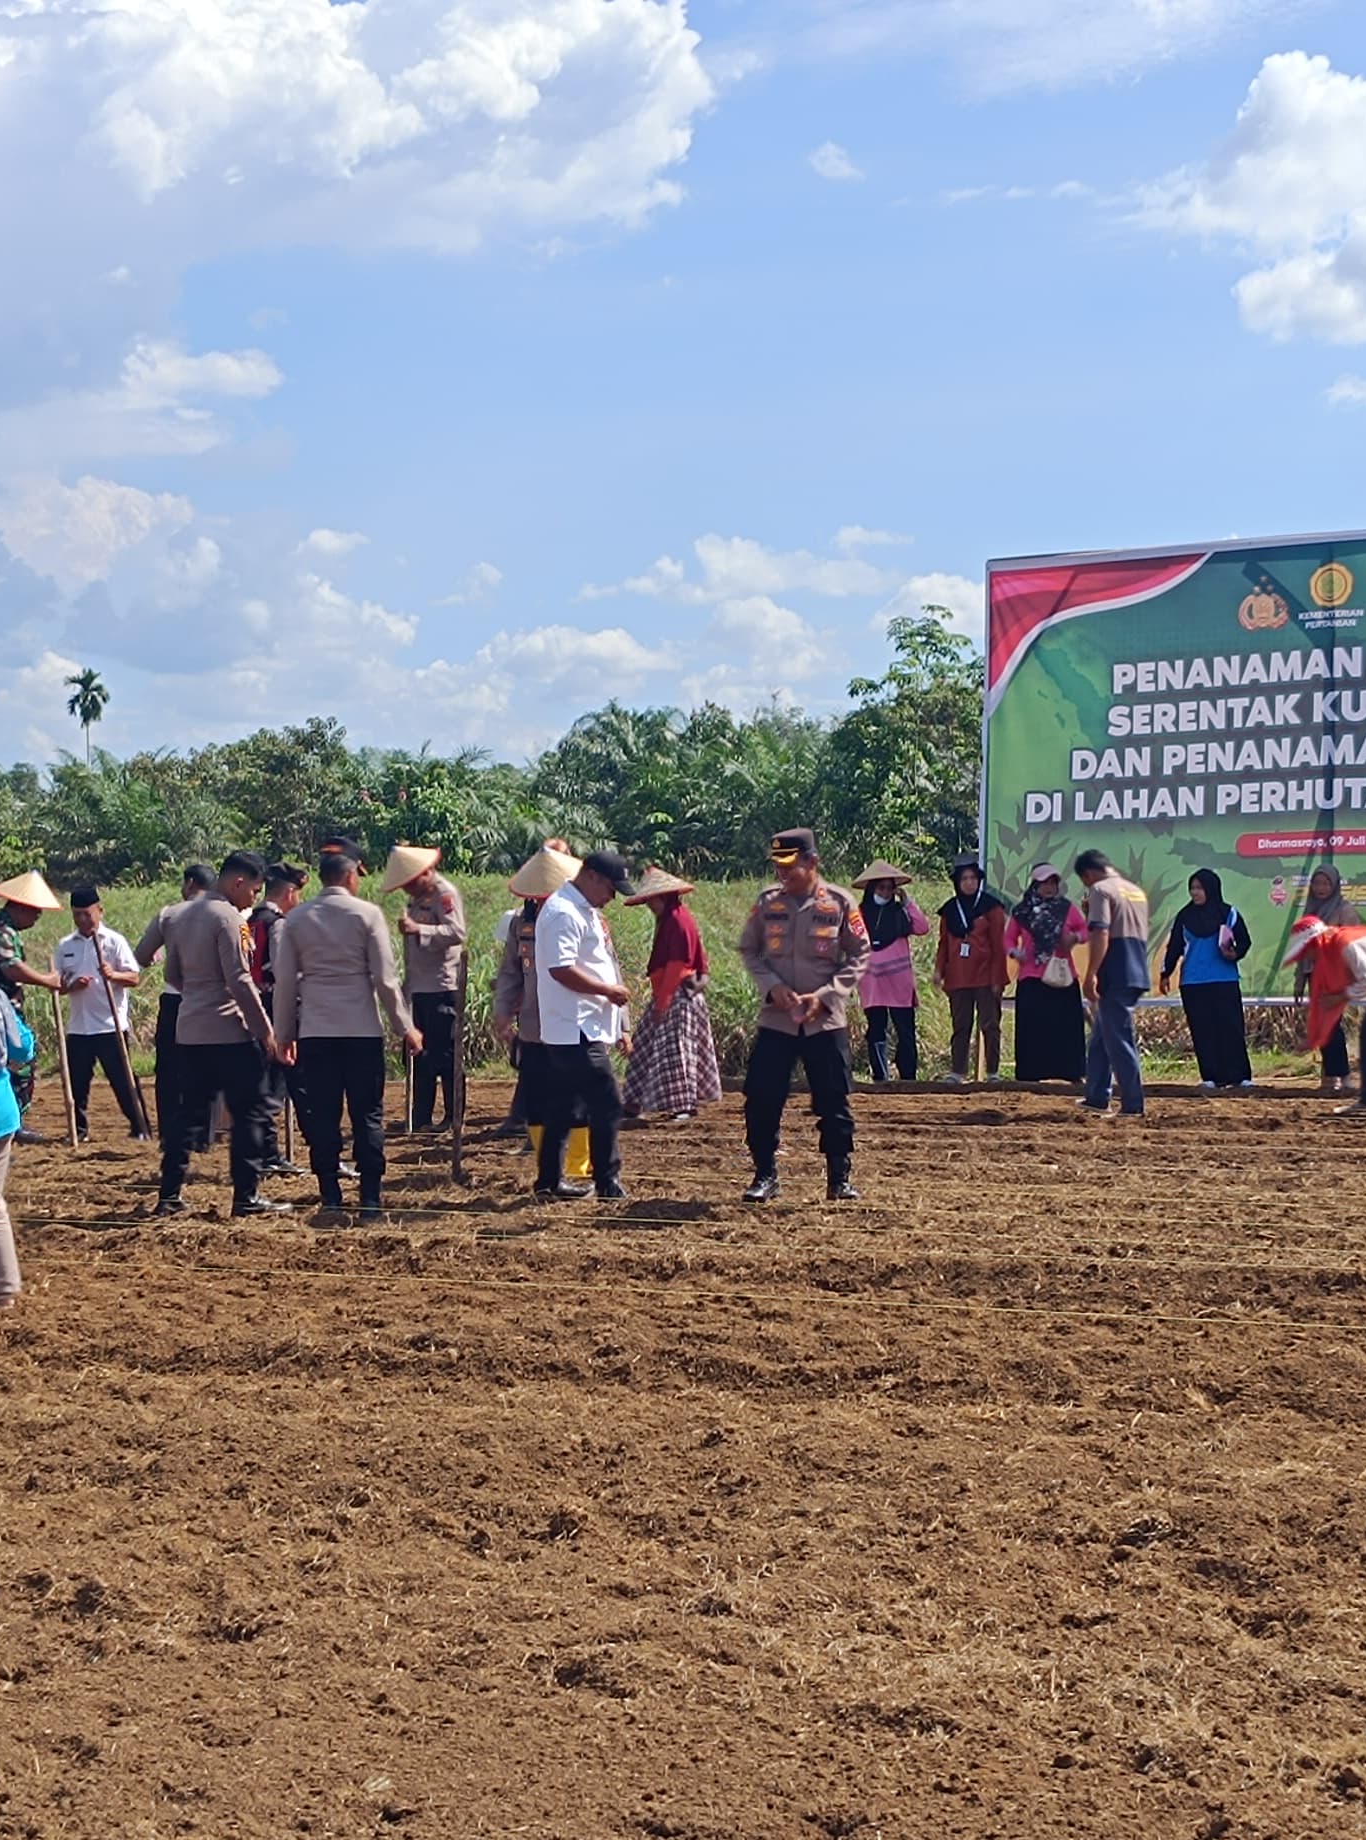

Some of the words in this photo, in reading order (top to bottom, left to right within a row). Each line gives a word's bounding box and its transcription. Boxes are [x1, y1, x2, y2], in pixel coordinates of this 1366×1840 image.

[1298, 609, 1364, 620] KEMENTERIAN
[1305, 619, 1356, 629] PERTANIAN
[1112, 646, 1363, 695] PENANAMAN
[1107, 693, 1302, 737] SERENTAK
[1071, 746, 1151, 780] DAN
[1025, 791, 1062, 823] DI
[1074, 785, 1204, 822] LAHAN
[1329, 837, 1344, 847] 09
[1347, 835, 1366, 846] Juli
